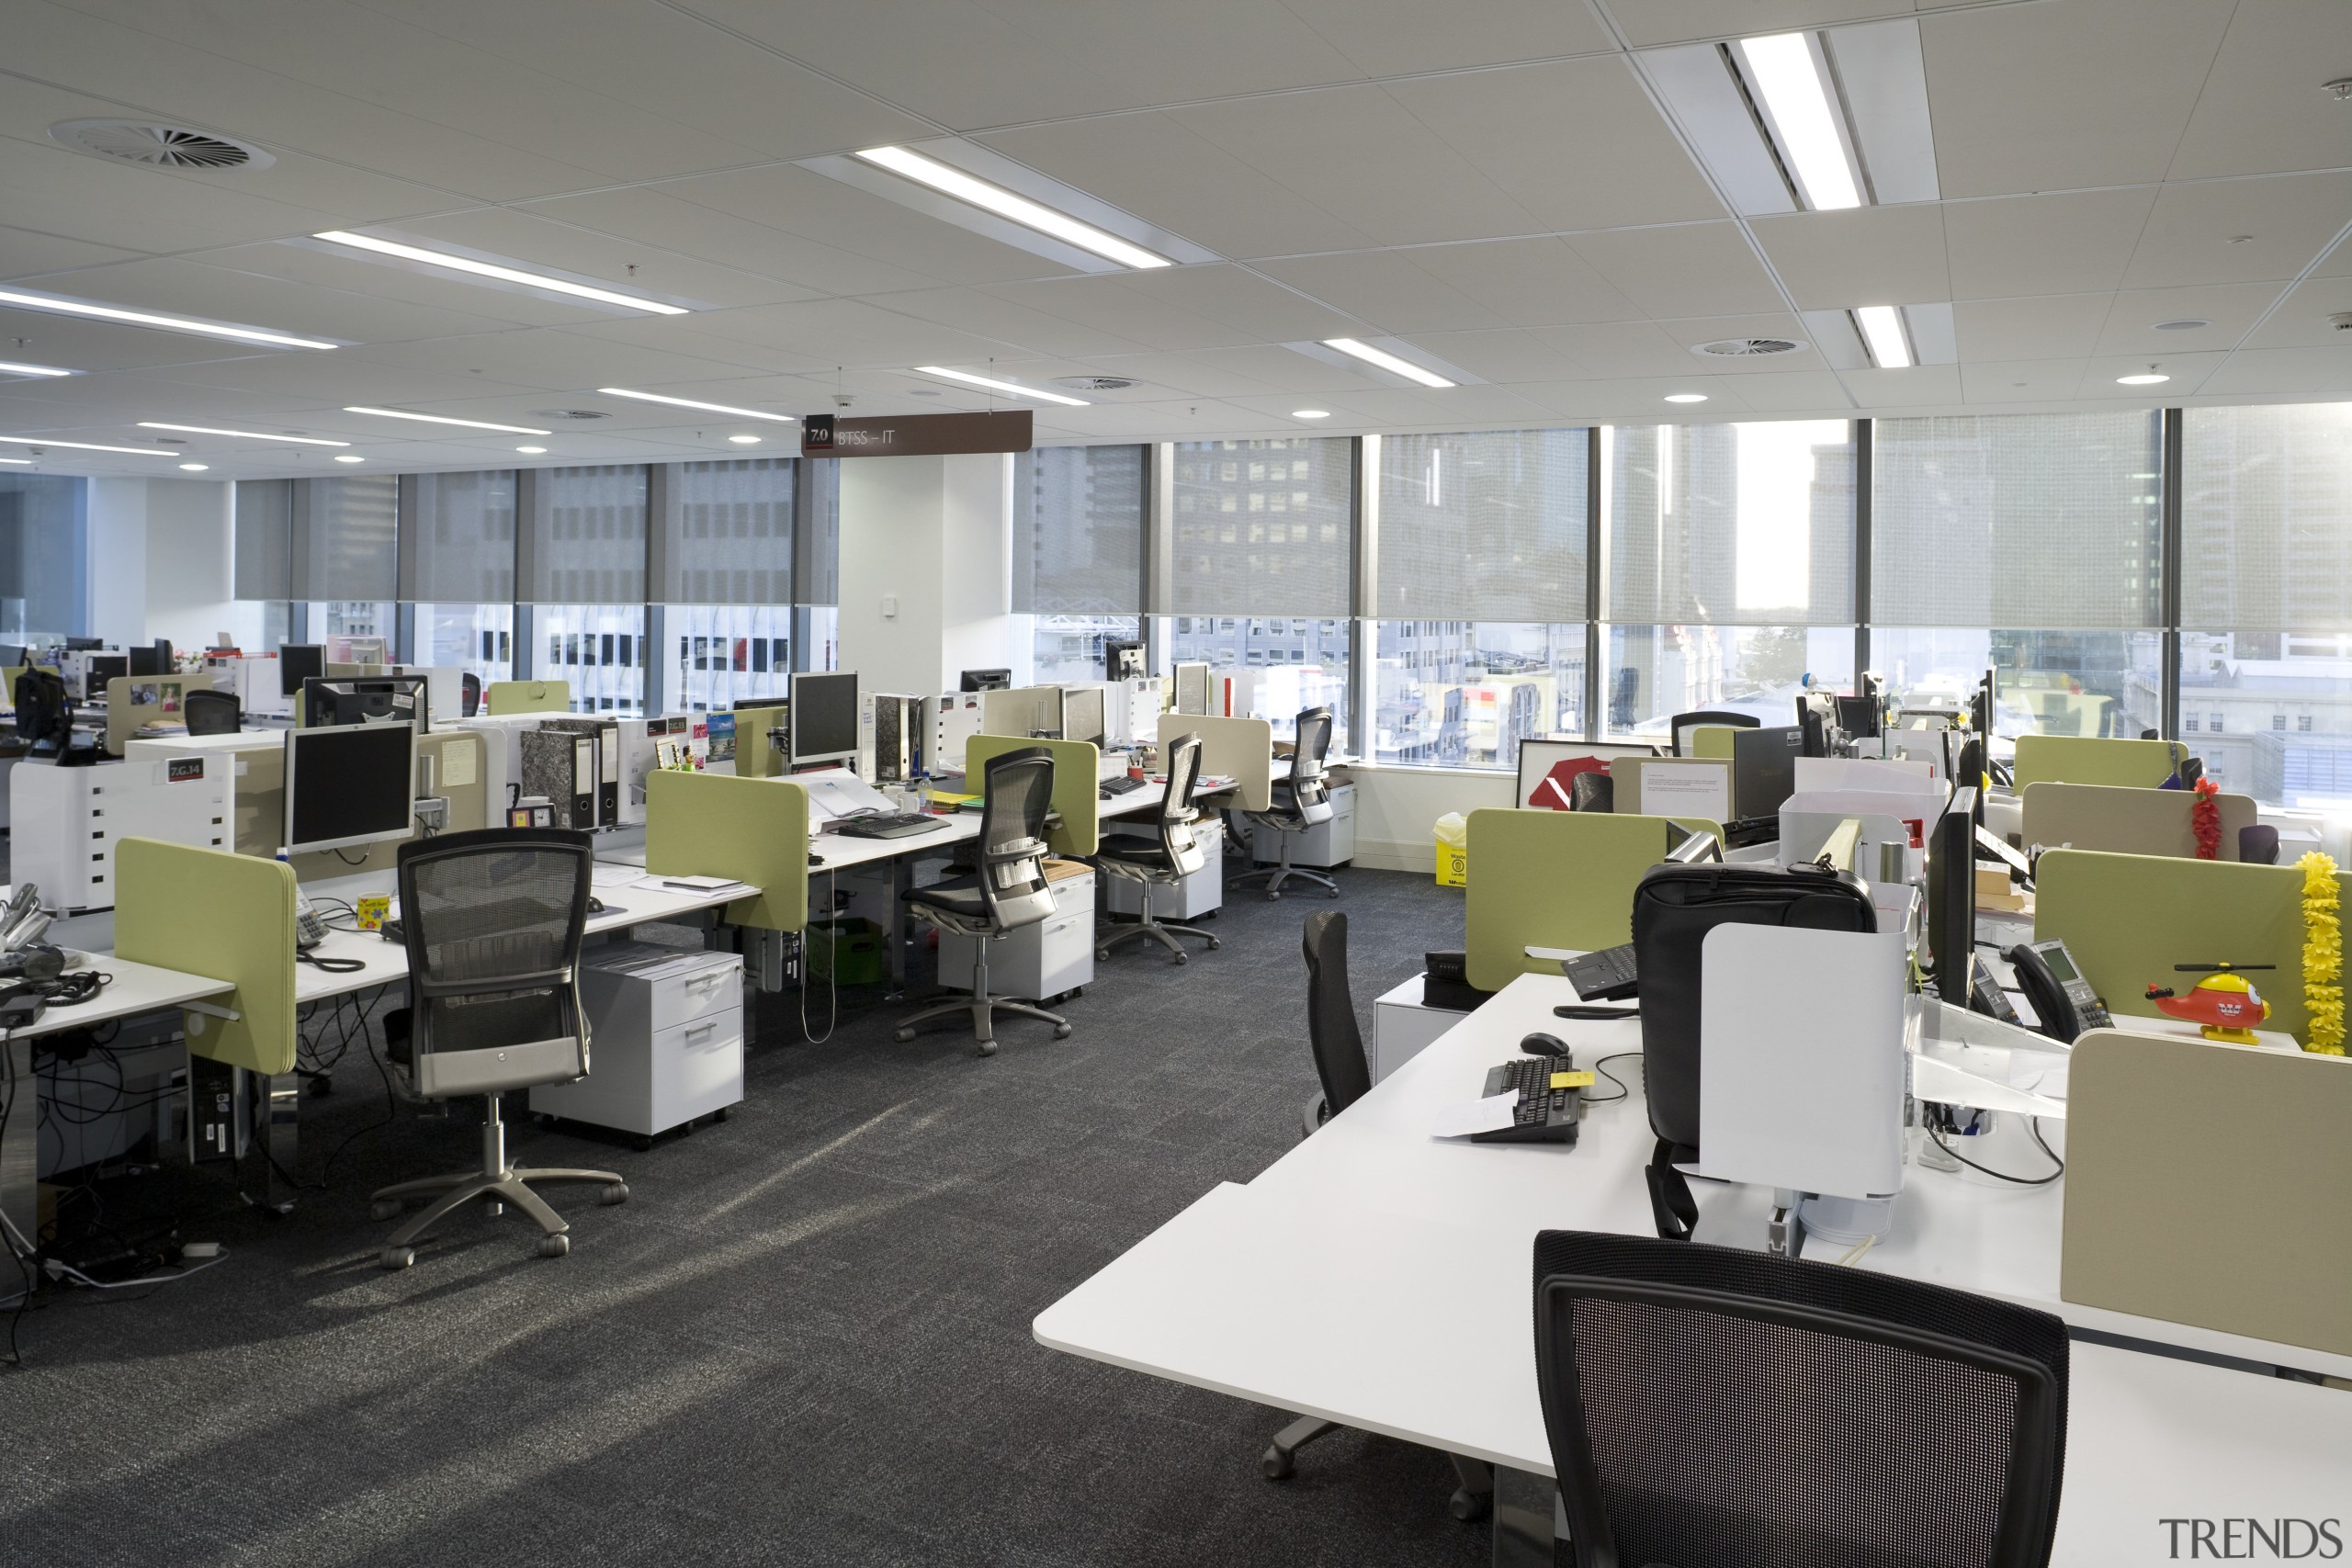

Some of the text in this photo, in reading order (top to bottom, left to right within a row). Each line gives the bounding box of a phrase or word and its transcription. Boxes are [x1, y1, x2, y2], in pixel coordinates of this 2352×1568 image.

[810, 428, 829, 442] 7.0
[838, 430, 868, 446] BTSS
[882, 429, 896, 445] IT
[170, 764, 200, 777] 7.G.14
